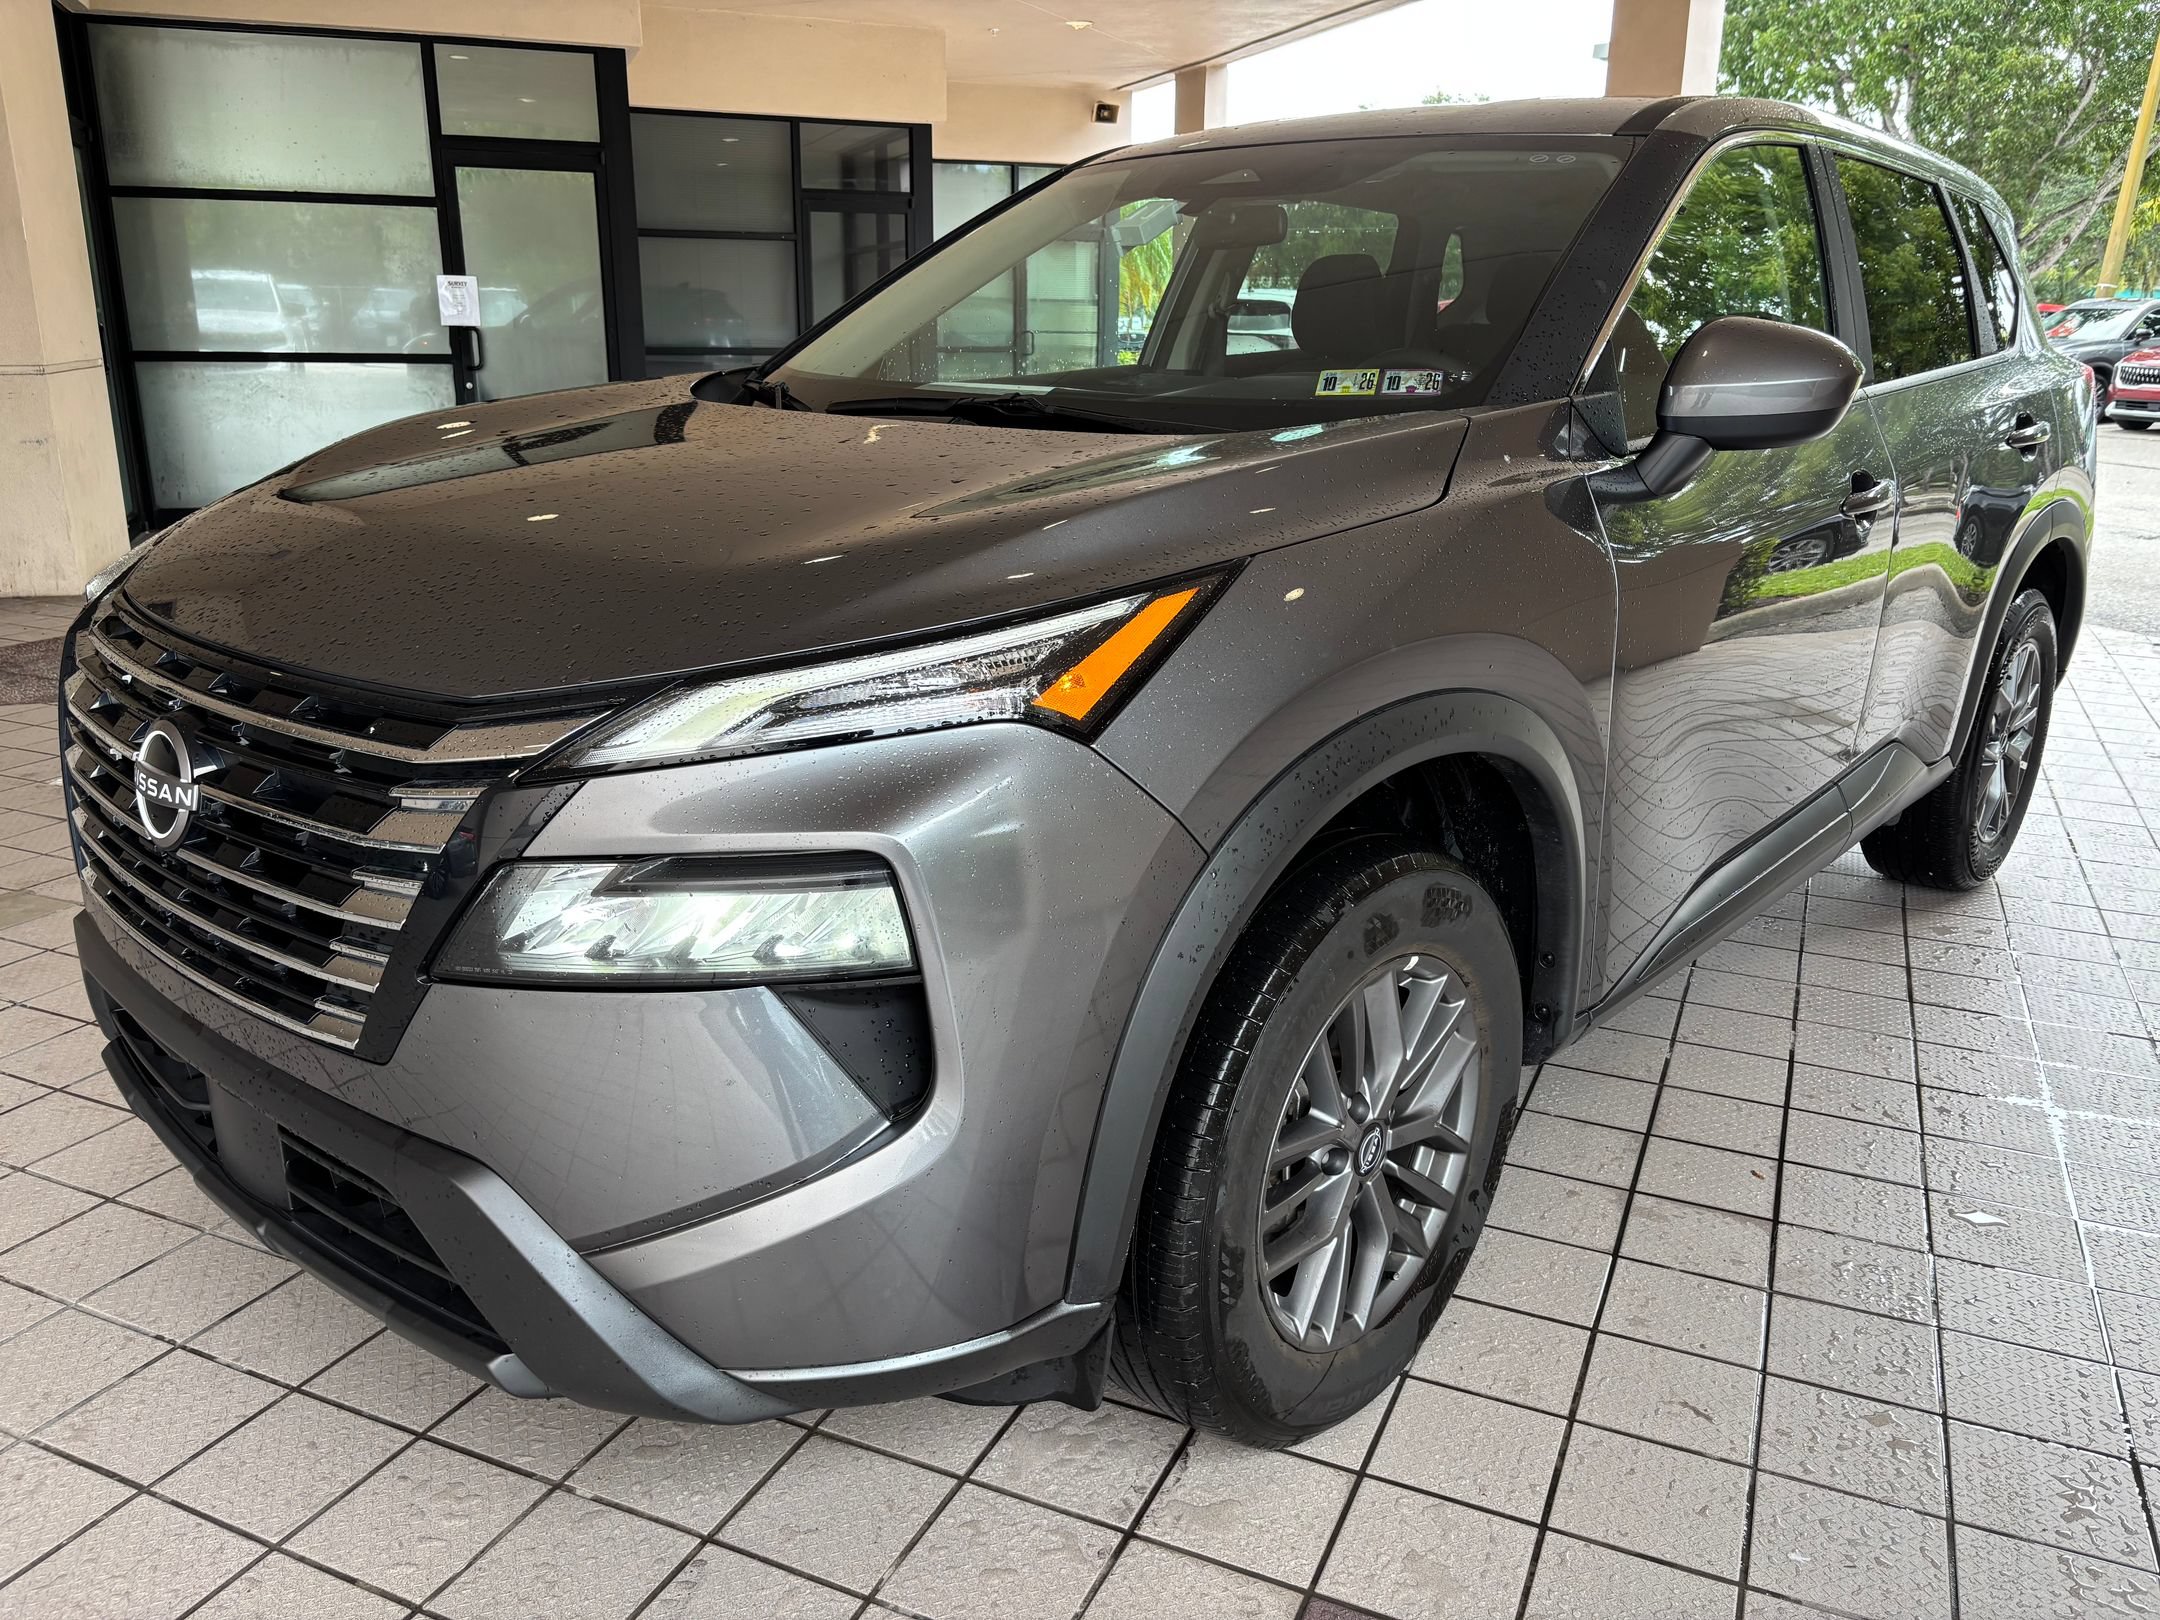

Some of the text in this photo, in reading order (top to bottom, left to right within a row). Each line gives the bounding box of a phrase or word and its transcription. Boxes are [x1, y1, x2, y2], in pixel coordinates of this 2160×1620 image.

[1322, 376, 1338, 391] 10
[1359, 372, 1376, 390] 26
[1386, 372, 1441, 391] 10 26
[135, 768, 193, 807] ISSAN
